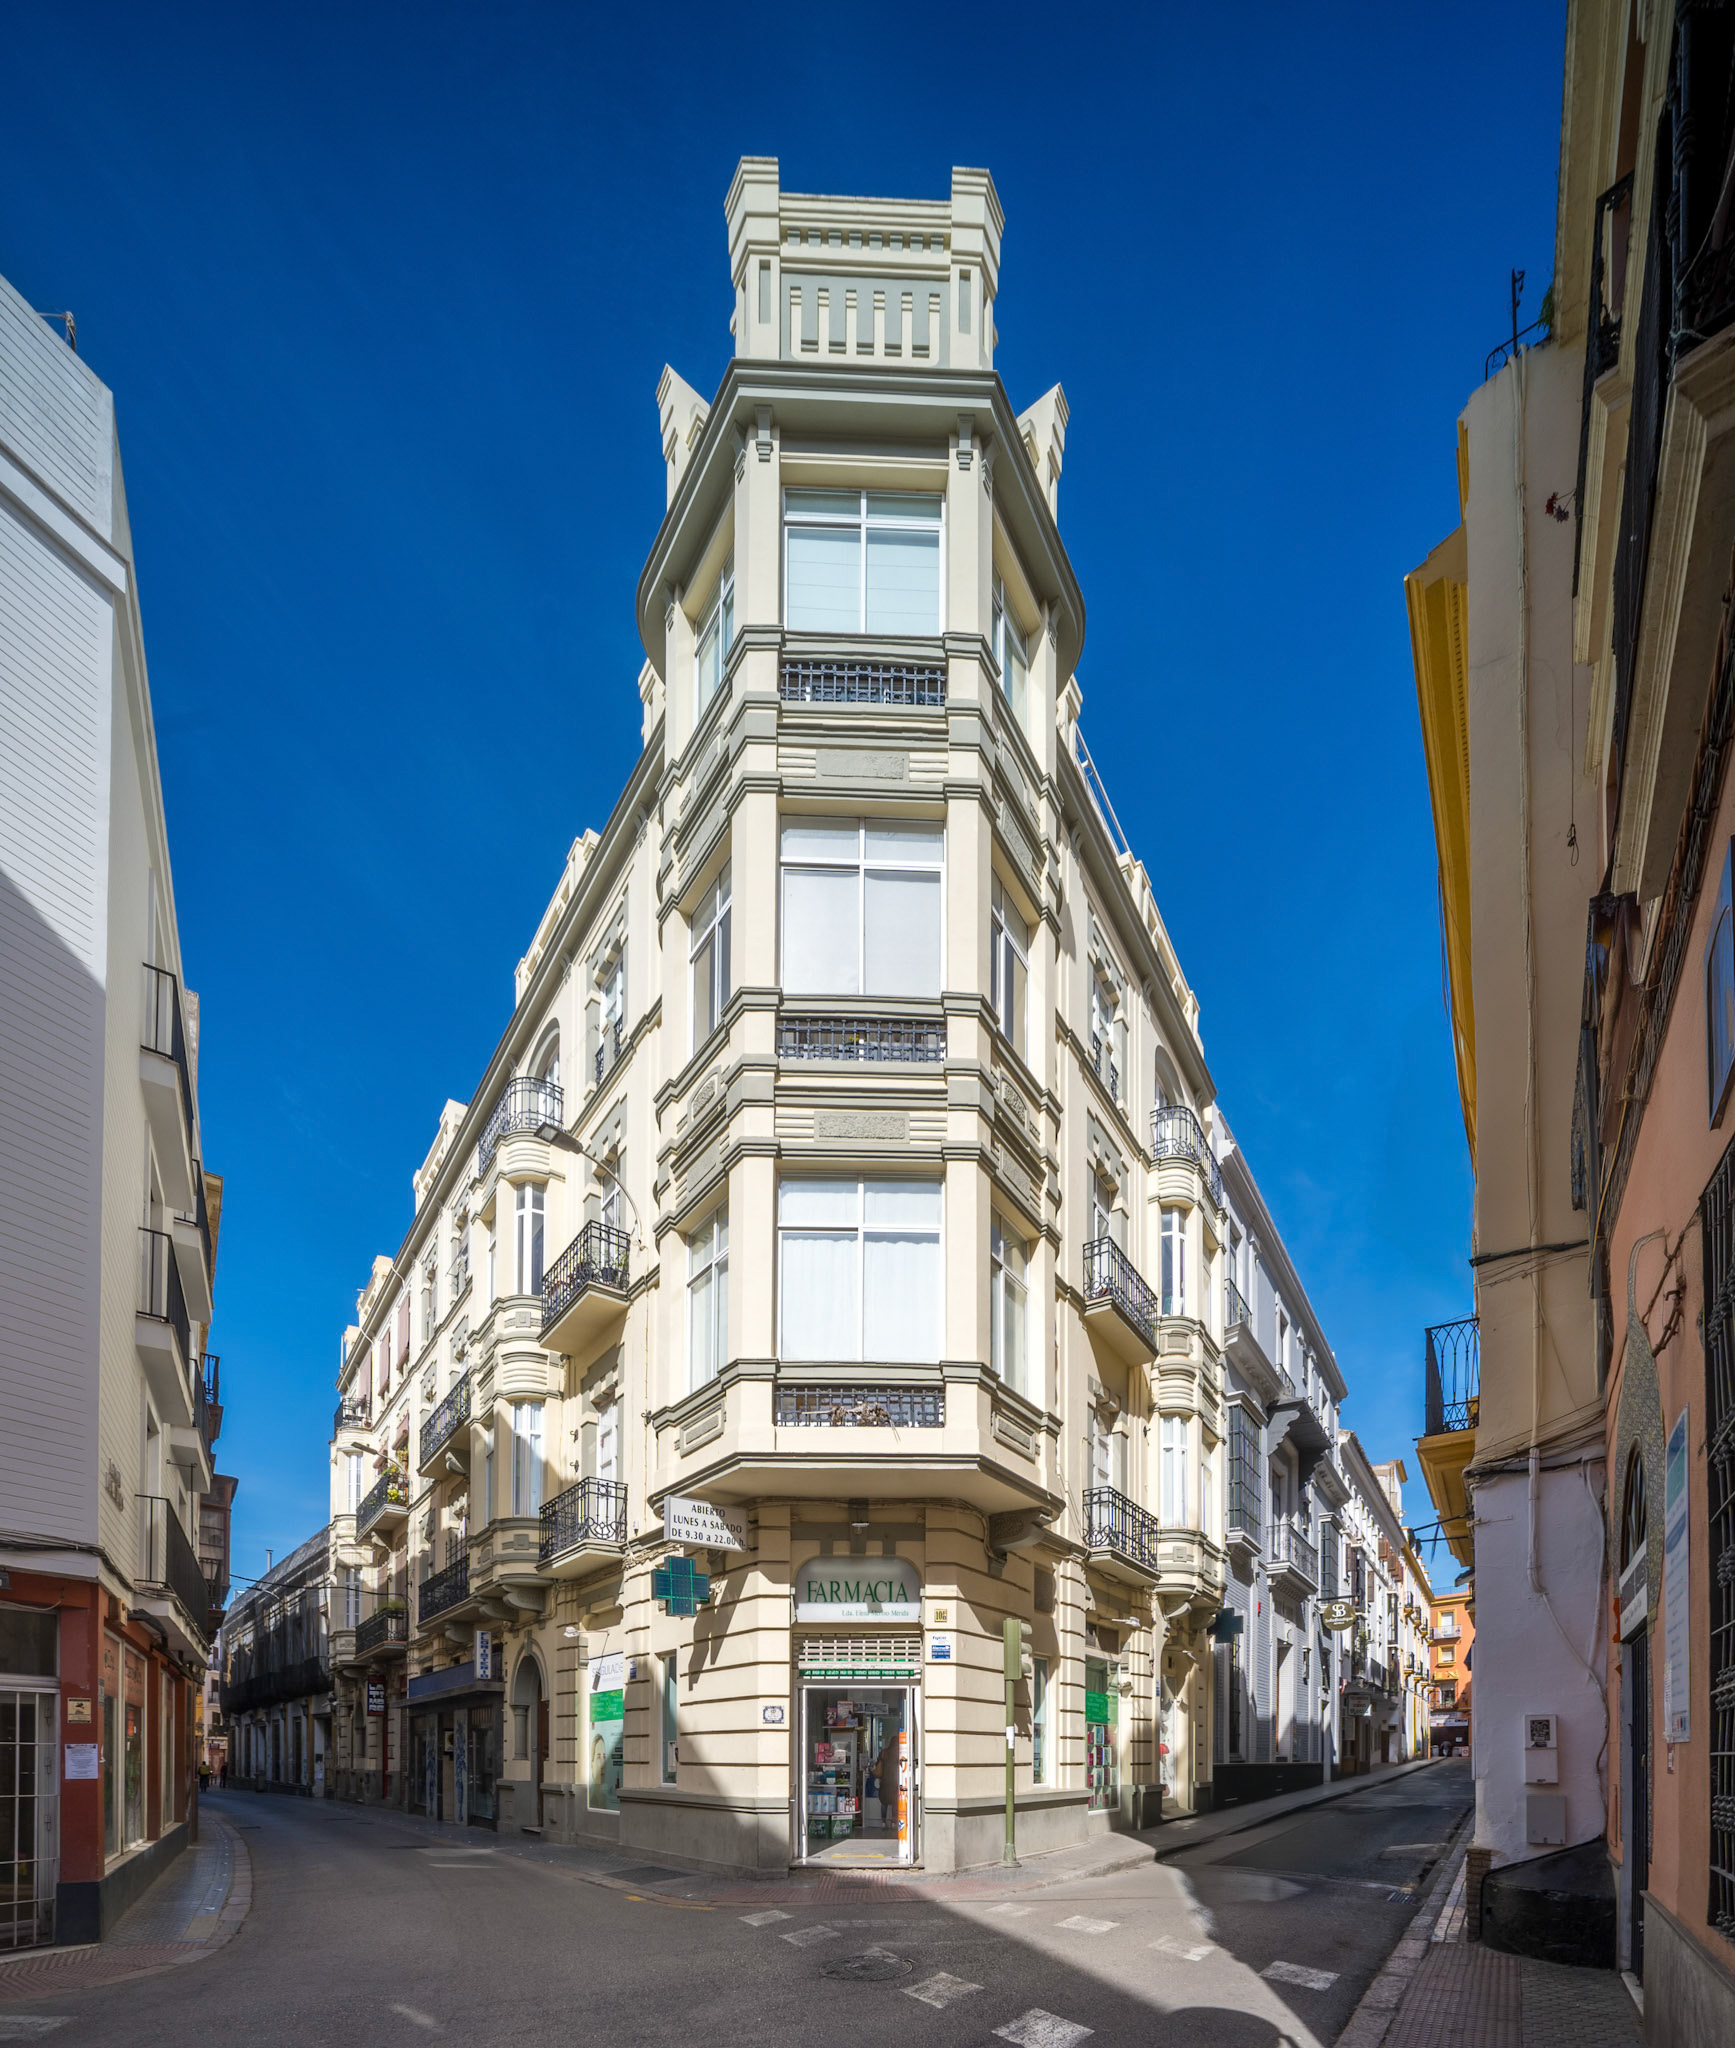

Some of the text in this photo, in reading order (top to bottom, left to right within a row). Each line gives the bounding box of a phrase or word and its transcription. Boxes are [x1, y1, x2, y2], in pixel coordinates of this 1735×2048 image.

[691, 1504, 726, 1518] ABIERTO
[673, 1514, 742, 1534] LUNES A SABADO
[671, 1527, 682, 1538] DE
[685, 1530, 703, 1541] 9.30
[706, 1534, 711, 1542] a
[714, 1534, 736, 1546] 22.00
[807, 1580, 909, 1603] FARMACIA
